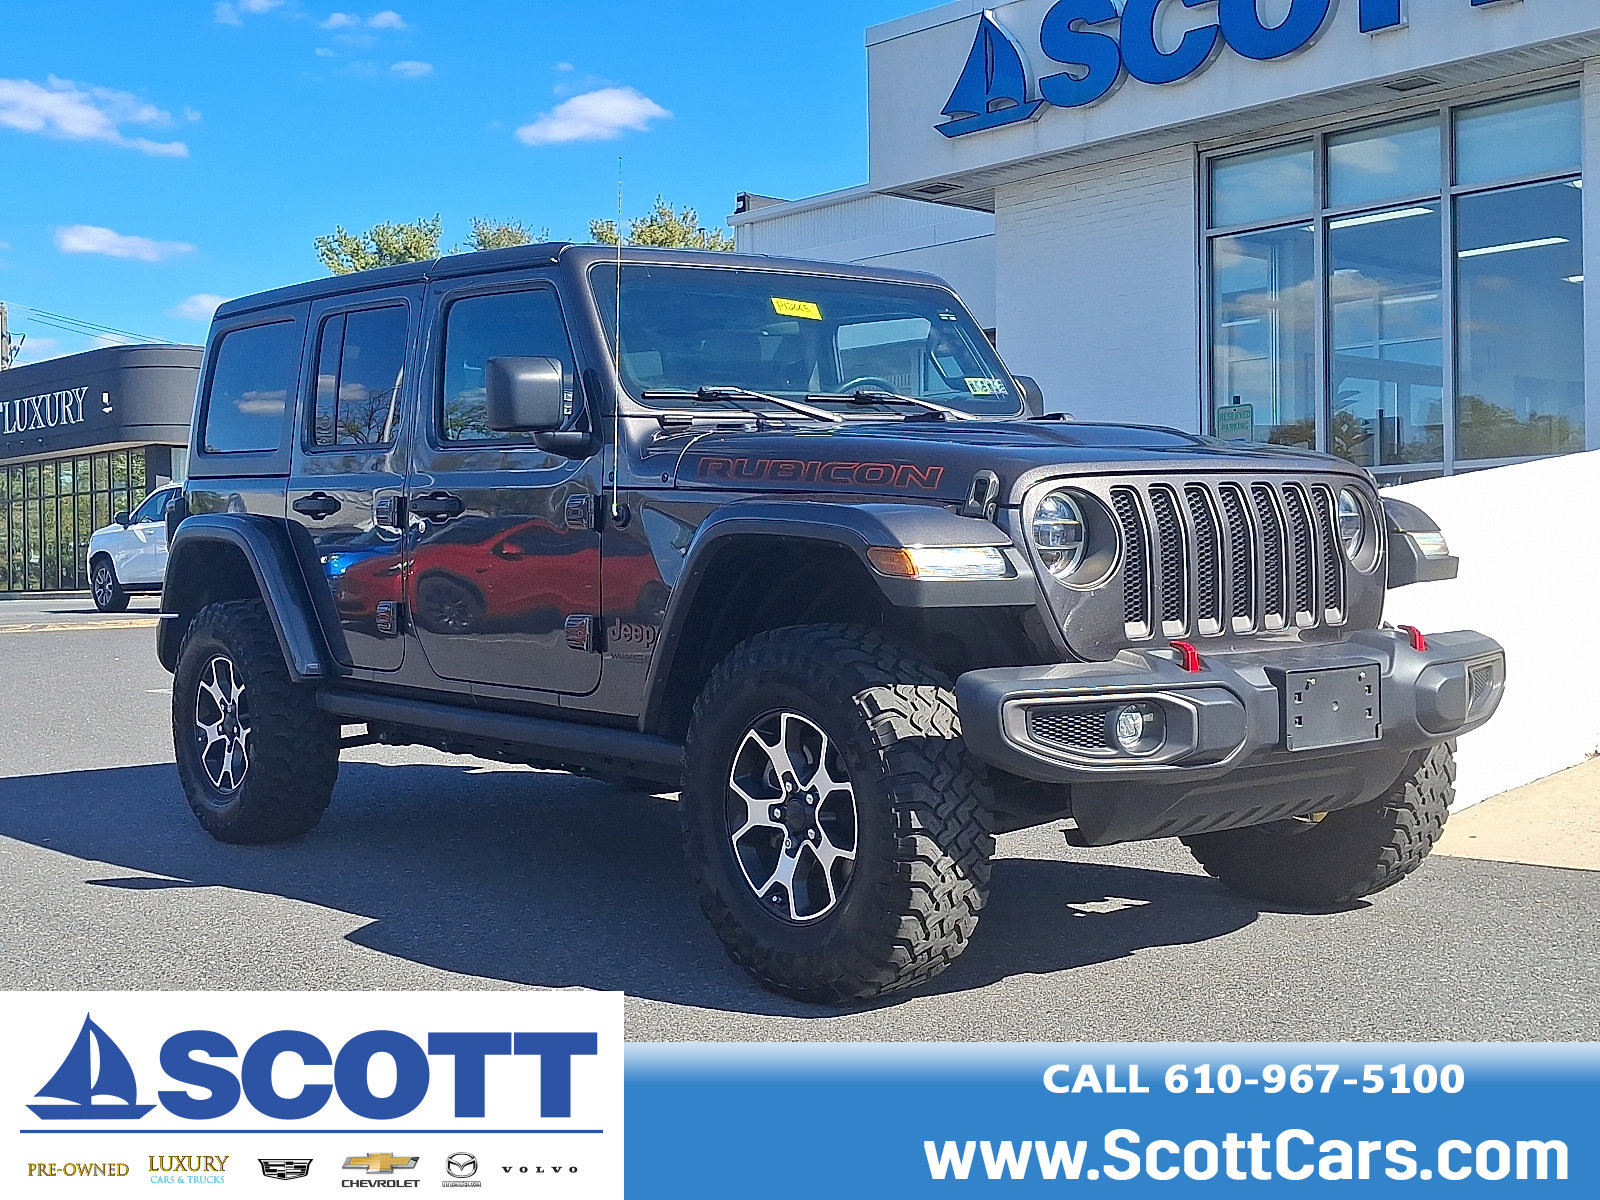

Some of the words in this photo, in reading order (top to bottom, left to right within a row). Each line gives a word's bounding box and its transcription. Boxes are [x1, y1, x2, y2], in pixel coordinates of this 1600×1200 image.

[1040, 0, 1512, 107] SCO
[3, 386, 89, 434] LUXURY
[1221, 421, 1249, 432] PARKING
[697, 457, 944, 489] RUBICON
[607, 617, 656, 648] Jeep
